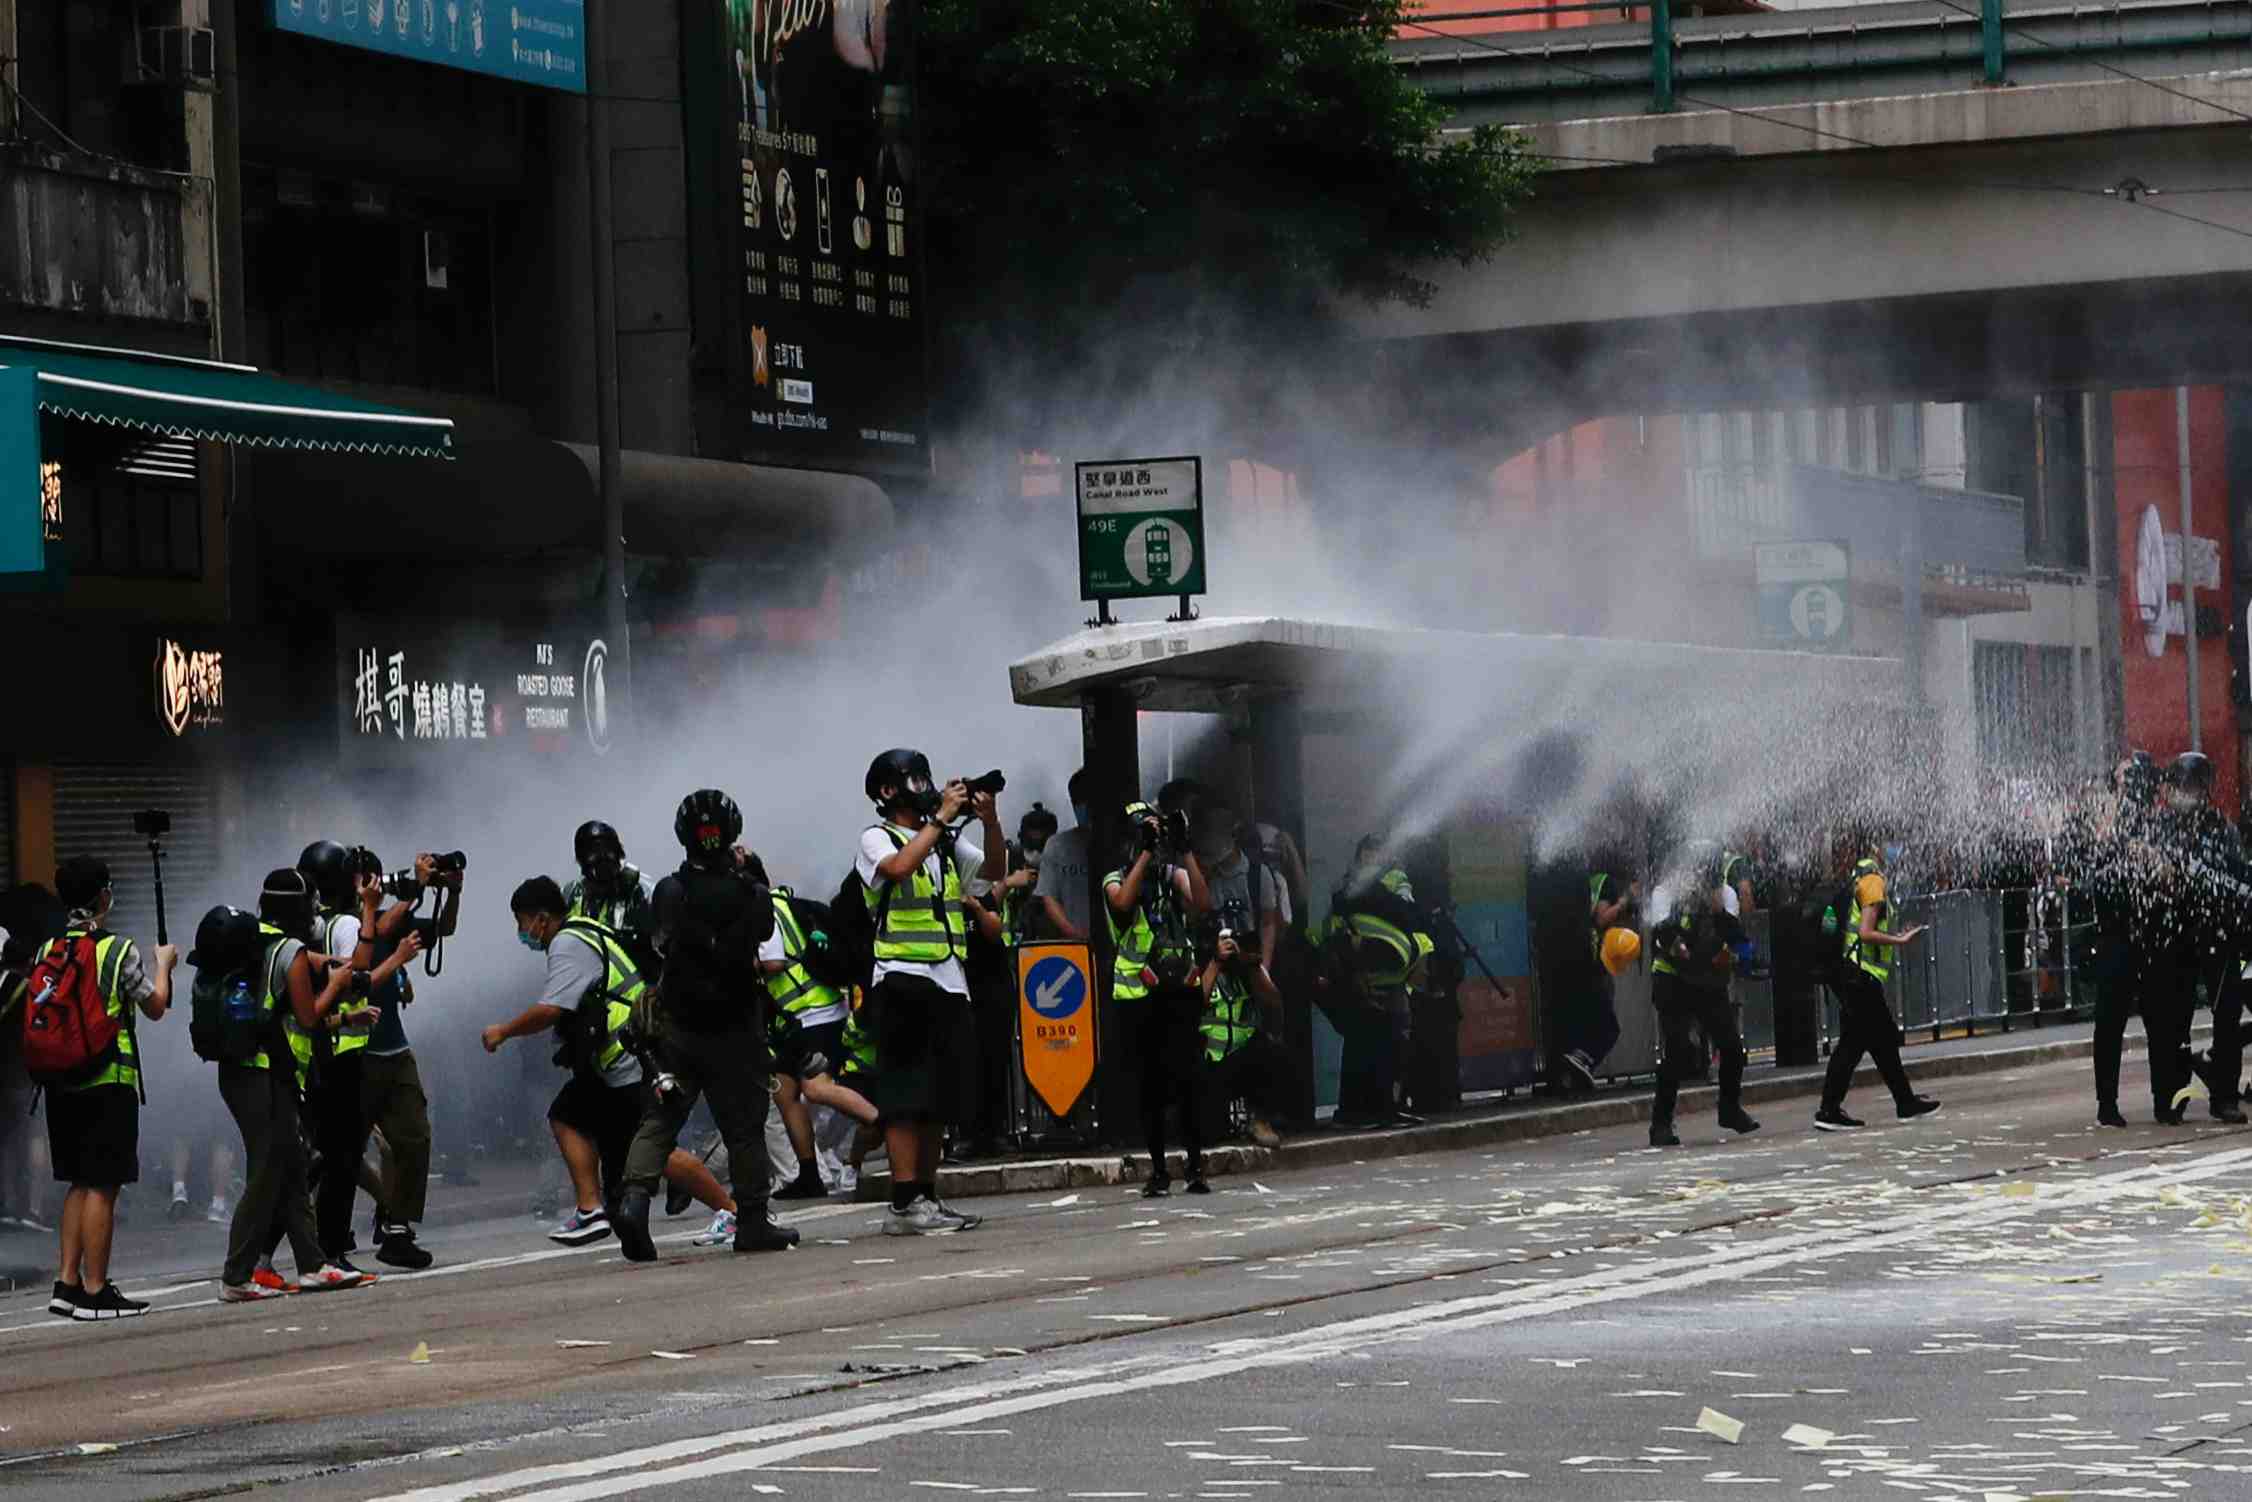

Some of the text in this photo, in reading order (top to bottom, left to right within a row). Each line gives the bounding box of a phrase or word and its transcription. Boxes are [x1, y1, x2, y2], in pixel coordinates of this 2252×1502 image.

[1086, 488, 1168, 499] Canal Road West
[1088, 519, 1117, 533] 49E
[517, 674, 575, 697] ROASTED GOOSE
[526, 707, 569, 728] RESTAURANT
[1037, 1025, 1076, 1037] B390
